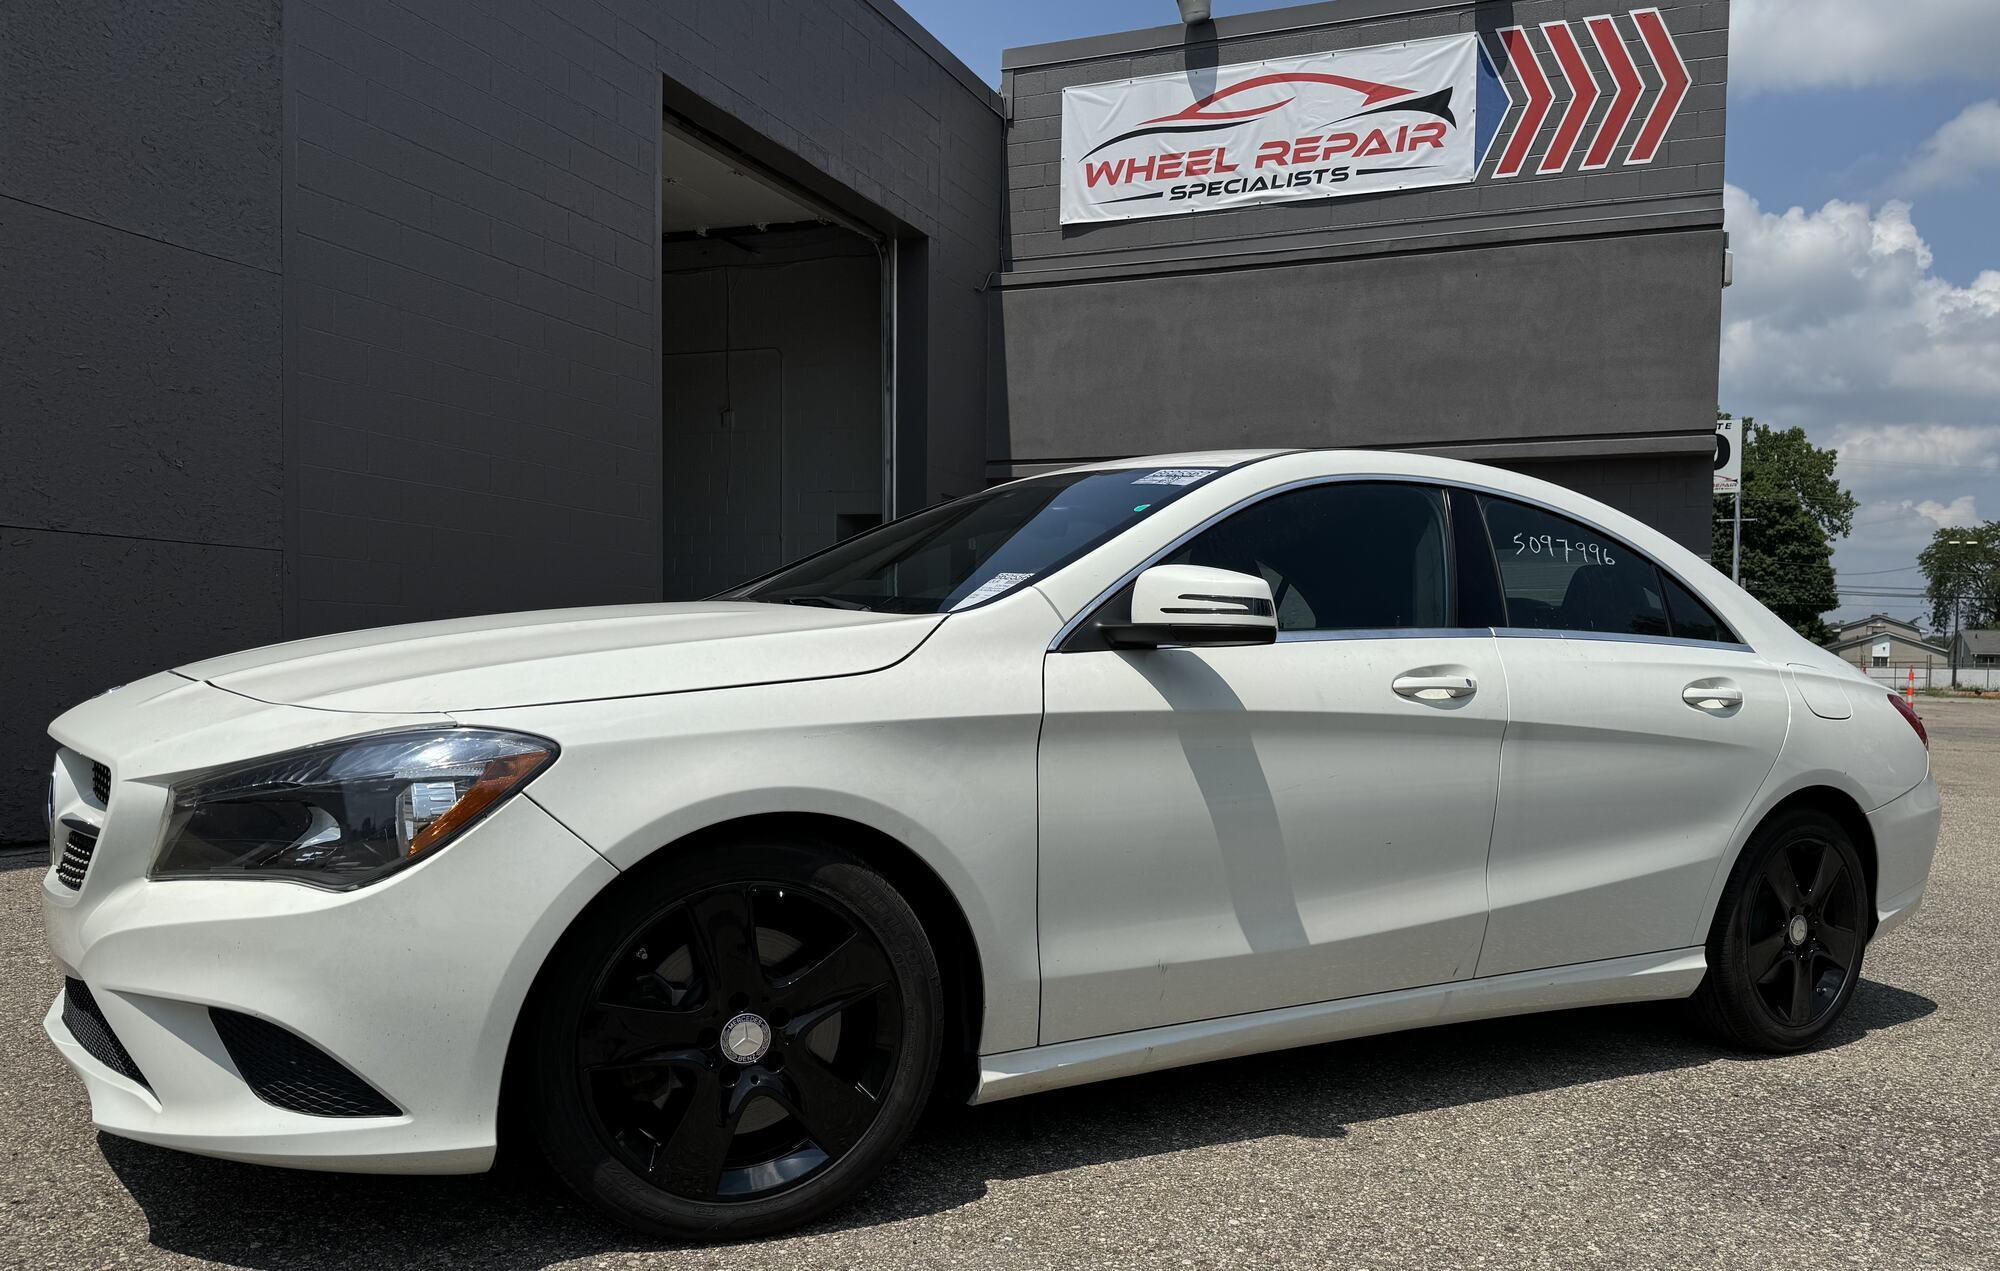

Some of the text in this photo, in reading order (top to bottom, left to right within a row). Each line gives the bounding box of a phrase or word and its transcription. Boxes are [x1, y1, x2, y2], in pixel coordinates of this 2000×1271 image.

[1085, 122, 1446, 188] WHEEL REPAIR
[1169, 165, 1350, 201] SPECIALISTS
[1513, 532, 1616, 566] 5097996
[728, 1016, 763, 1029] MERCEDES
[737, 1053, 757, 1062] BENZ
